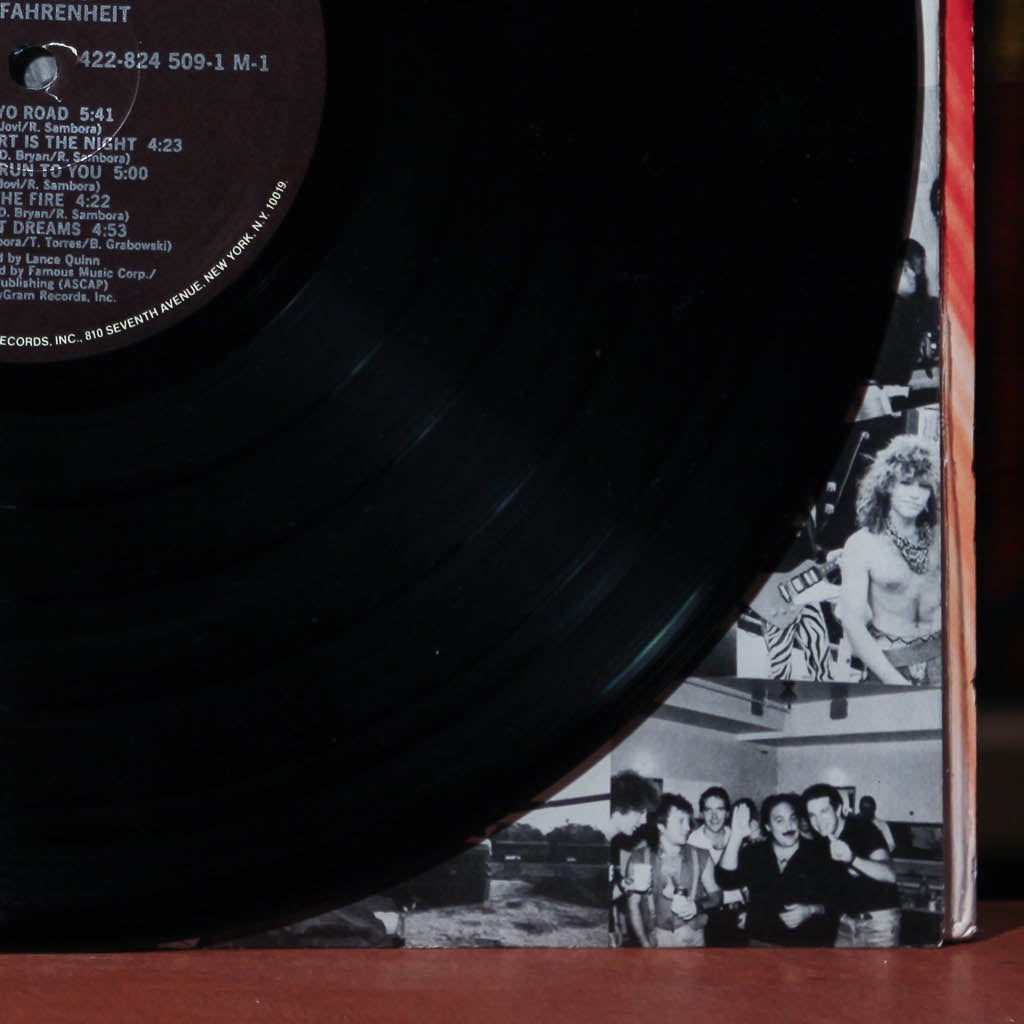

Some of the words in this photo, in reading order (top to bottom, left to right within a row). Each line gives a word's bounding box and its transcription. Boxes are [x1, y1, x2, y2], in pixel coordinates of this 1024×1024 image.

[0, 3, 131, 23] FAHRENHEIT
[81, 51, 160, 69] 422-824
[168, 52, 224, 71] 509-1
[233, 54, 269, 72] M-1
[23, 106, 69, 121] ROAD
[80, 107, 114, 122] 5:41
[44, 123, 102, 135] Sambora)
[24, 135, 39, 148] IS
[45, 135, 78, 149] THE
[84, 136, 137, 151] NIGHT
[147, 137, 182, 152] 4:23
[16, 150, 69, 163] Bryan/R.
[74, 151, 130, 164] Sambora)
[40, 164, 62, 177] TO
[69, 164, 102, 179] YOU
[113, 166, 148, 180] 5:00
[43, 179, 100, 192] Sambora)
[29, 192, 64, 206] FIRE
[76, 194, 110, 208] 4:22
[15, 207, 67, 220] Bryan/R.
[72, 208, 129, 222] Sambora)
[13, 220, 81, 236] DREAMS
[92, 223, 127, 237] 4:53
[45, 237, 102, 249] Torres/B.
[106, 239, 173, 253] Grabowski)
[8, 252, 21, 264] by
[27, 253, 61, 264] Lance
[65, 254, 100, 266] Quinn
[10, 266, 24, 277] by
[29, 266, 74, 277] Famous
[79, 267, 113, 278] Music
[59, 278, 108, 291] (ASCAP)
[85, 328, 104, 341] 810
[106, 307, 159, 336] SEVENTH
[203, 258, 228, 283] NEW
[95, 291, 116, 302] Inc.
